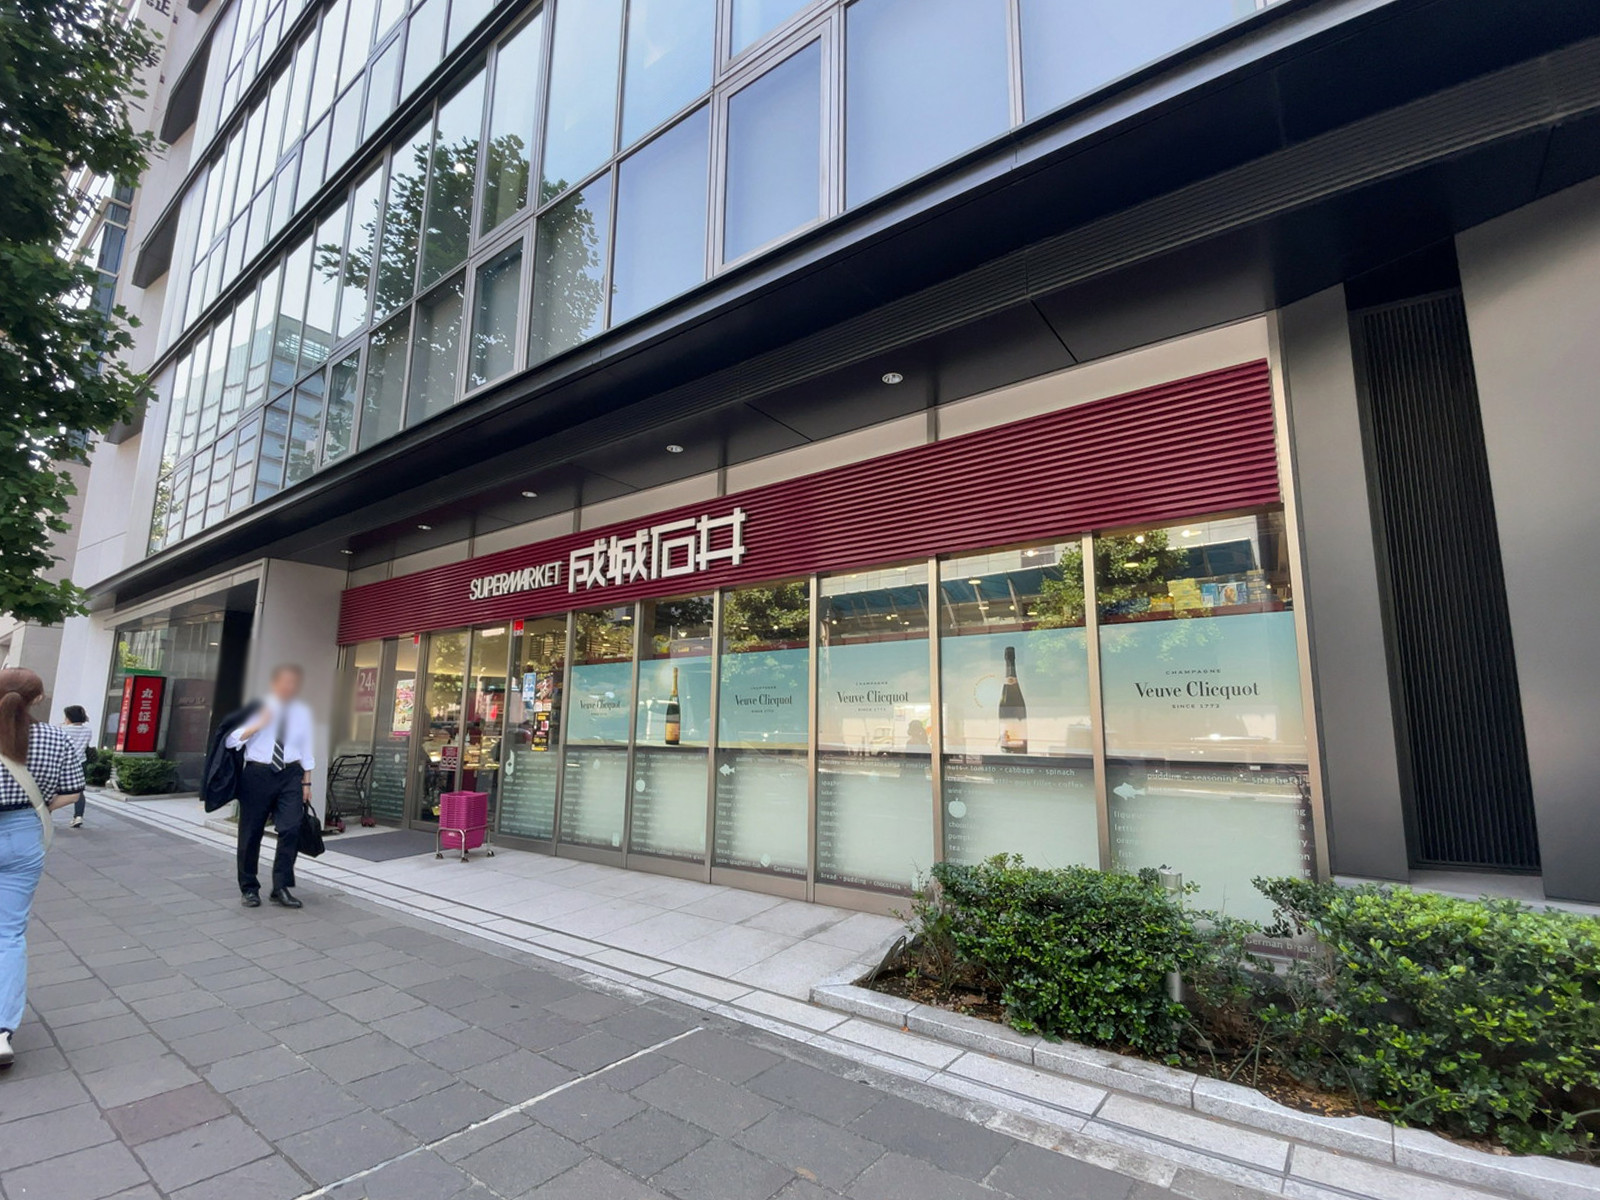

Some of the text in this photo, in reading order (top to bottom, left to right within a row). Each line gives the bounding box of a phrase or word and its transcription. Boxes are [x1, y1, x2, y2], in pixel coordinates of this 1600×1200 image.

[568, 507, 748, 593] 成城石井
[469, 560, 565, 600] SUPERMARKET
[1165, 668, 1222, 676] CHAMPAGNE
[837, 690, 909, 705] Veuve Clicquot
[1134, 680, 1260, 700] Veuve Clicquot
[735, 693, 793, 707] Veuve Clicquot
[136, 688, 154, 734] 丸三証券
[1046, 768, 1075, 776] spinach
[1192, 774, 1238, 783] seasoning
[1245, 936, 1317, 955] German bread
